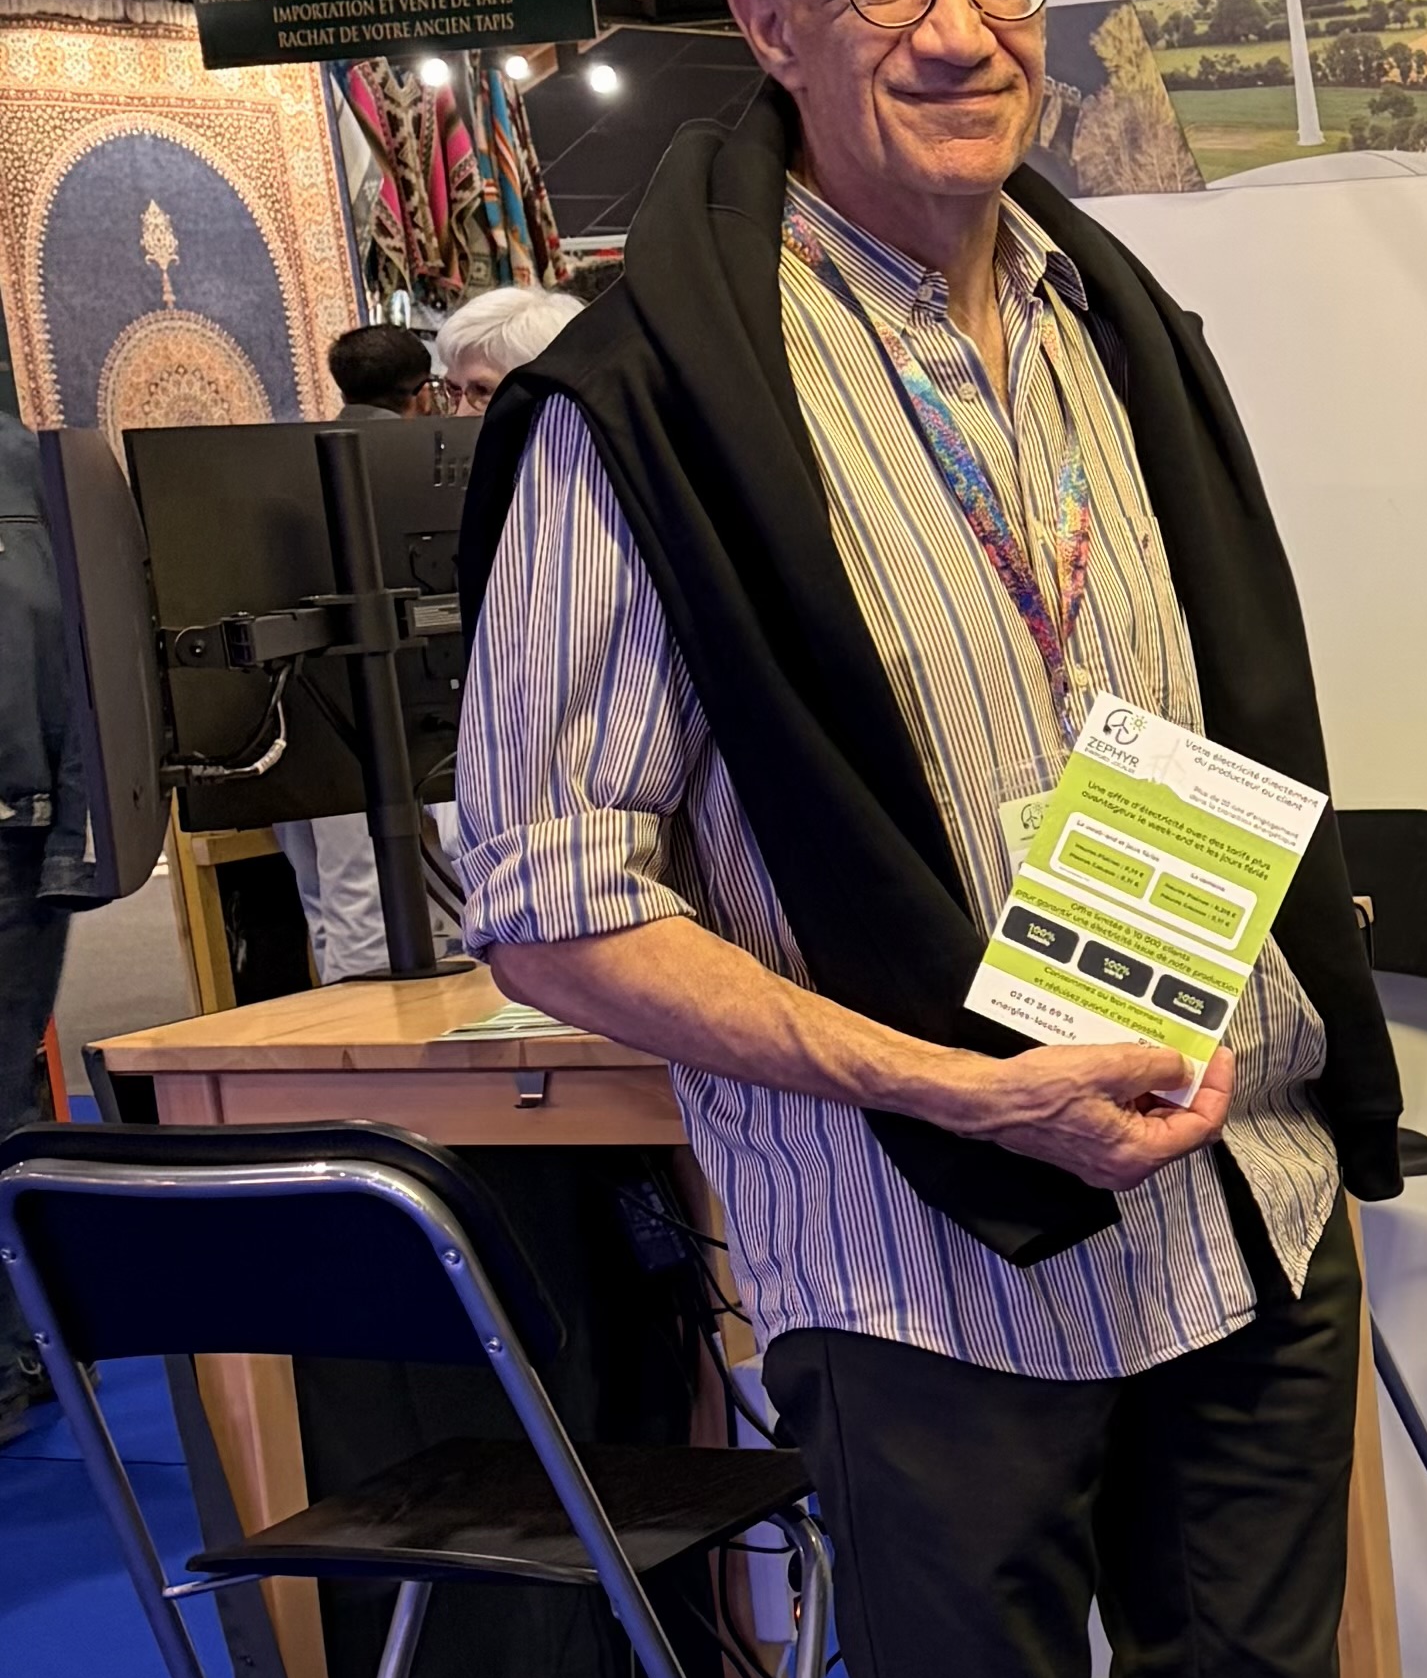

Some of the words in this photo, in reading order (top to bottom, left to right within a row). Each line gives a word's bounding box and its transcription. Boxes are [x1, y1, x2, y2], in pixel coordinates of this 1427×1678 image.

[274, 1, 376, 24] IMPORTATION
[278, 27, 334, 51] RACHAT
[339, 25, 360, 43] DE
[362, 22, 412, 43] VOTRE
[414, 18, 472, 38] ANCIEN
[476, 14, 514, 32] TAPIS
[1086, 736, 1141, 768] ZEPHYR
